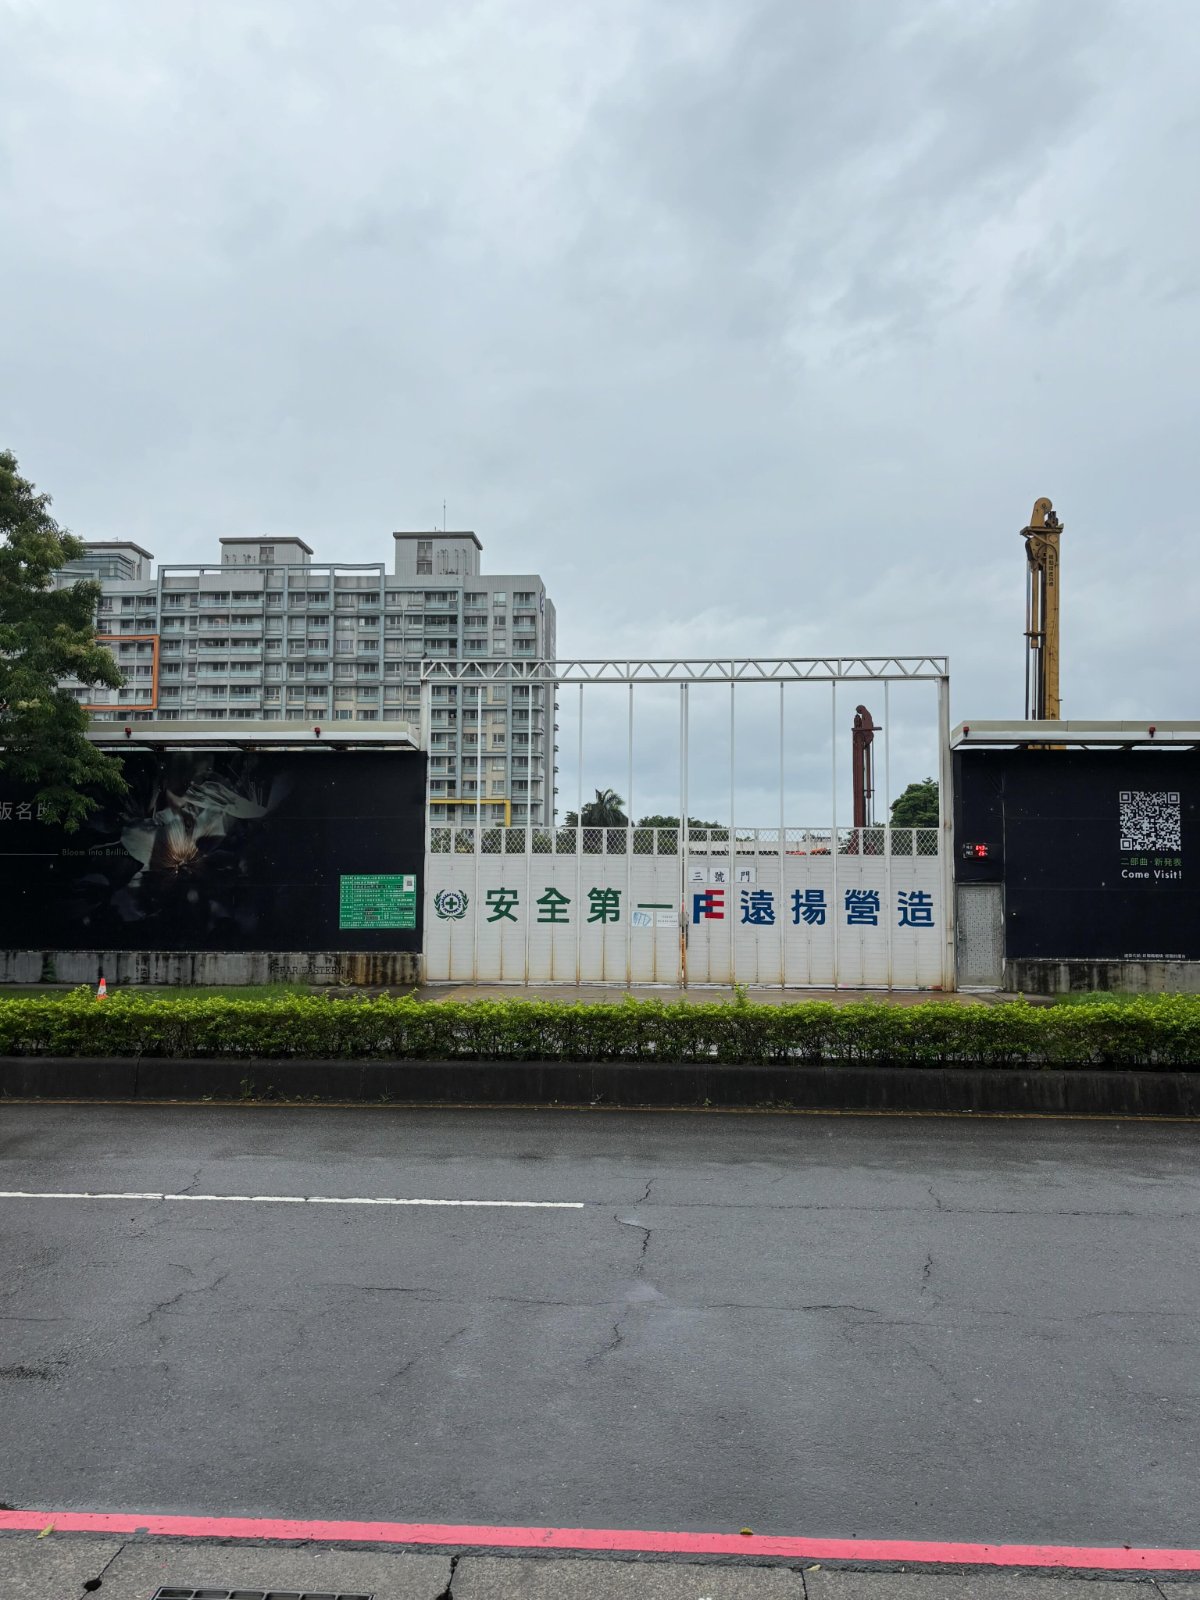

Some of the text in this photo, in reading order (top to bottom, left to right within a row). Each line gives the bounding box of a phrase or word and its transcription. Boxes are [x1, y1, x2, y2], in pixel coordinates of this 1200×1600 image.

[693, 871, 750, 883] 三號門
[1121, 869, 1182, 880] Come Visit!
[485, 887, 674, 924] 安全第一
[740, 889, 936, 928] 遠揚營造
[301, 966, 345, 975] EASTERN
